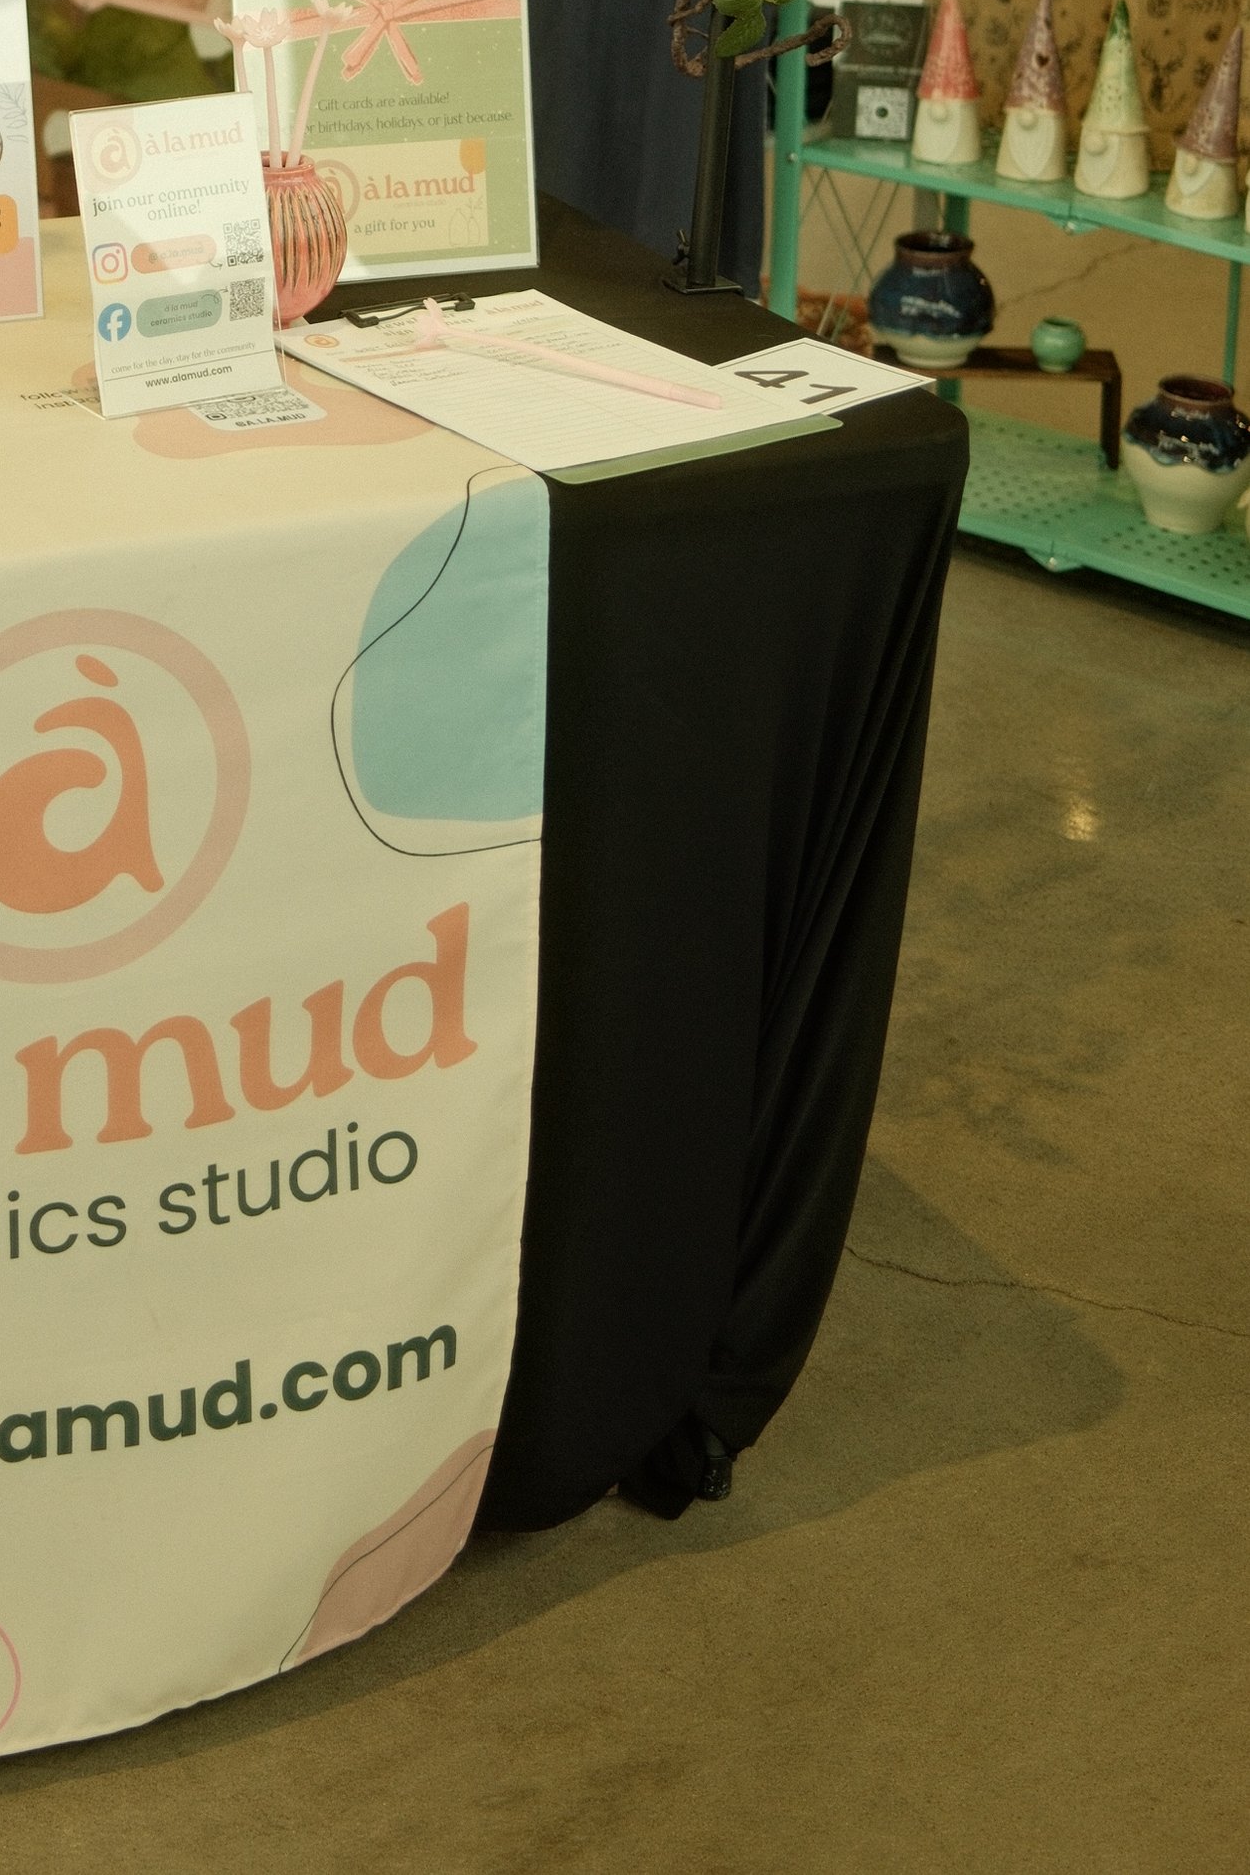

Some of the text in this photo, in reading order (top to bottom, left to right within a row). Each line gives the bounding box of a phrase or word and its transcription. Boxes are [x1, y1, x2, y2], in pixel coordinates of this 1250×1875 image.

[317, 91, 451, 113] Gift cards are available!
[317, 118, 373, 136] birthdays,
[376, 114, 424, 132] holidays,
[427, 115, 442, 126] or
[443, 109, 463, 127] just
[466, 109, 514, 125] because.
[145, 133, 161, 157] à
[164, 130, 187, 154] la
[188, 121, 245, 150] mud
[92, 177, 252, 217] join our community
[363, 176, 382, 202] à
[385, 174, 410, 199] la
[413, 174, 476, 198] mud
[146, 199, 203, 222] online!
[364, 219, 388, 236] gift
[389, 219, 410, 232] for
[411, 219, 437, 233] you
[150, 310, 214, 327] ceramics studio
[179, 300, 199, 311] mud
[111, 341, 256, 374] come for the clay, stay for the community
[145, 363, 234, 389] www.alamud.com
[733, 369, 858, 405] 41
[34, 395, 101, 410] instag
[14, 901, 478, 1155] mud
[157, 1121, 419, 1236] studio
